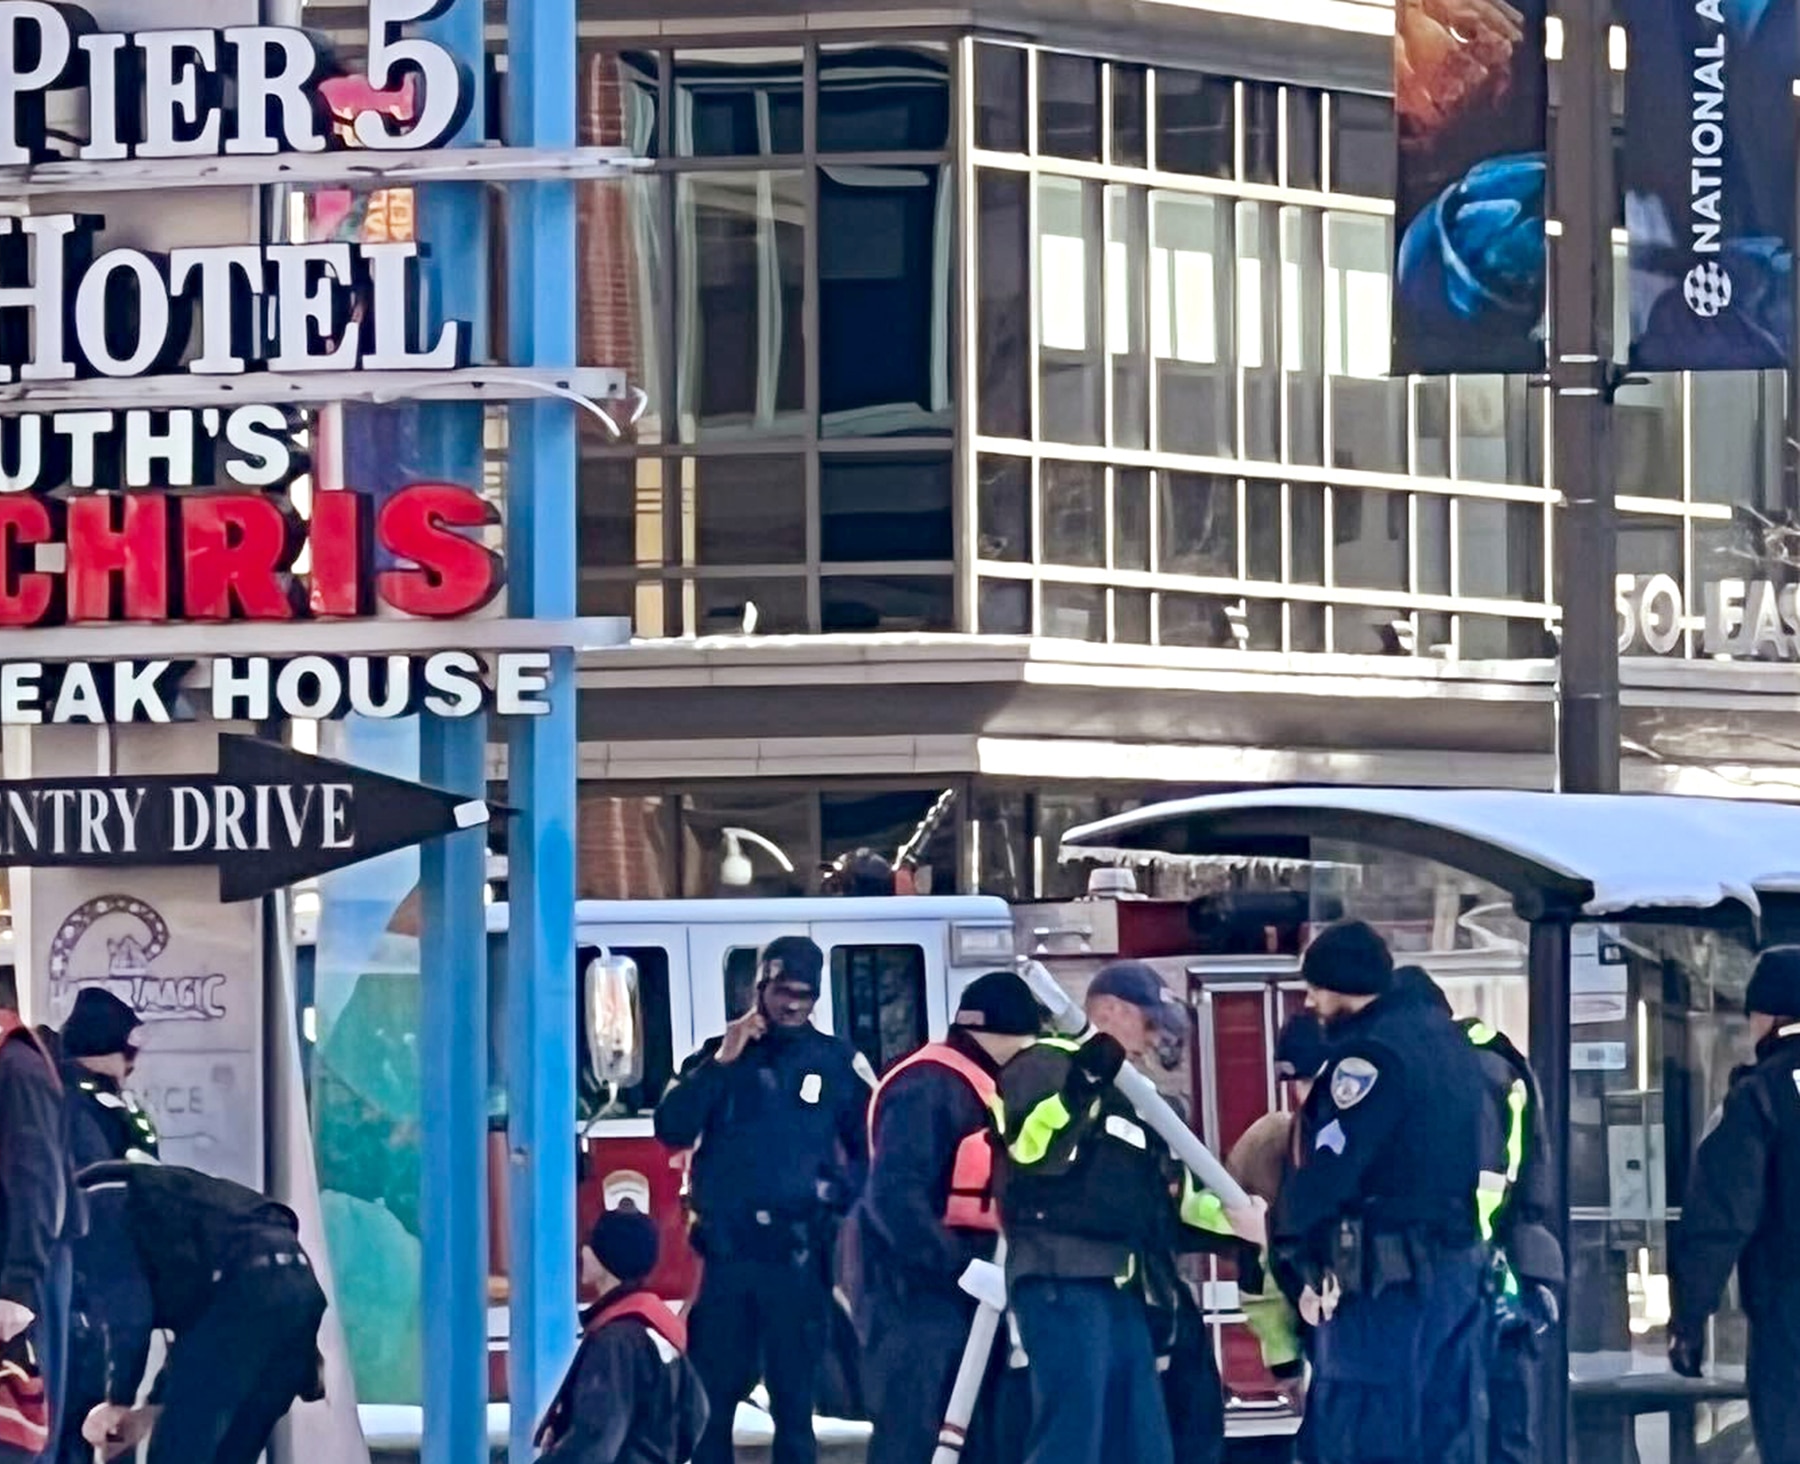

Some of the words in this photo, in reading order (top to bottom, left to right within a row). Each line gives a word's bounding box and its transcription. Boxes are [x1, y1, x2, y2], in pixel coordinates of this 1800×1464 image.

[353, 0, 461, 150] 5
[1691, 33, 1725, 253] NATIONAL
[1704, 577, 1800, 659] EA
[212, 650, 553, 722] HOUSE
[172, 782, 357, 853] DRIVE
